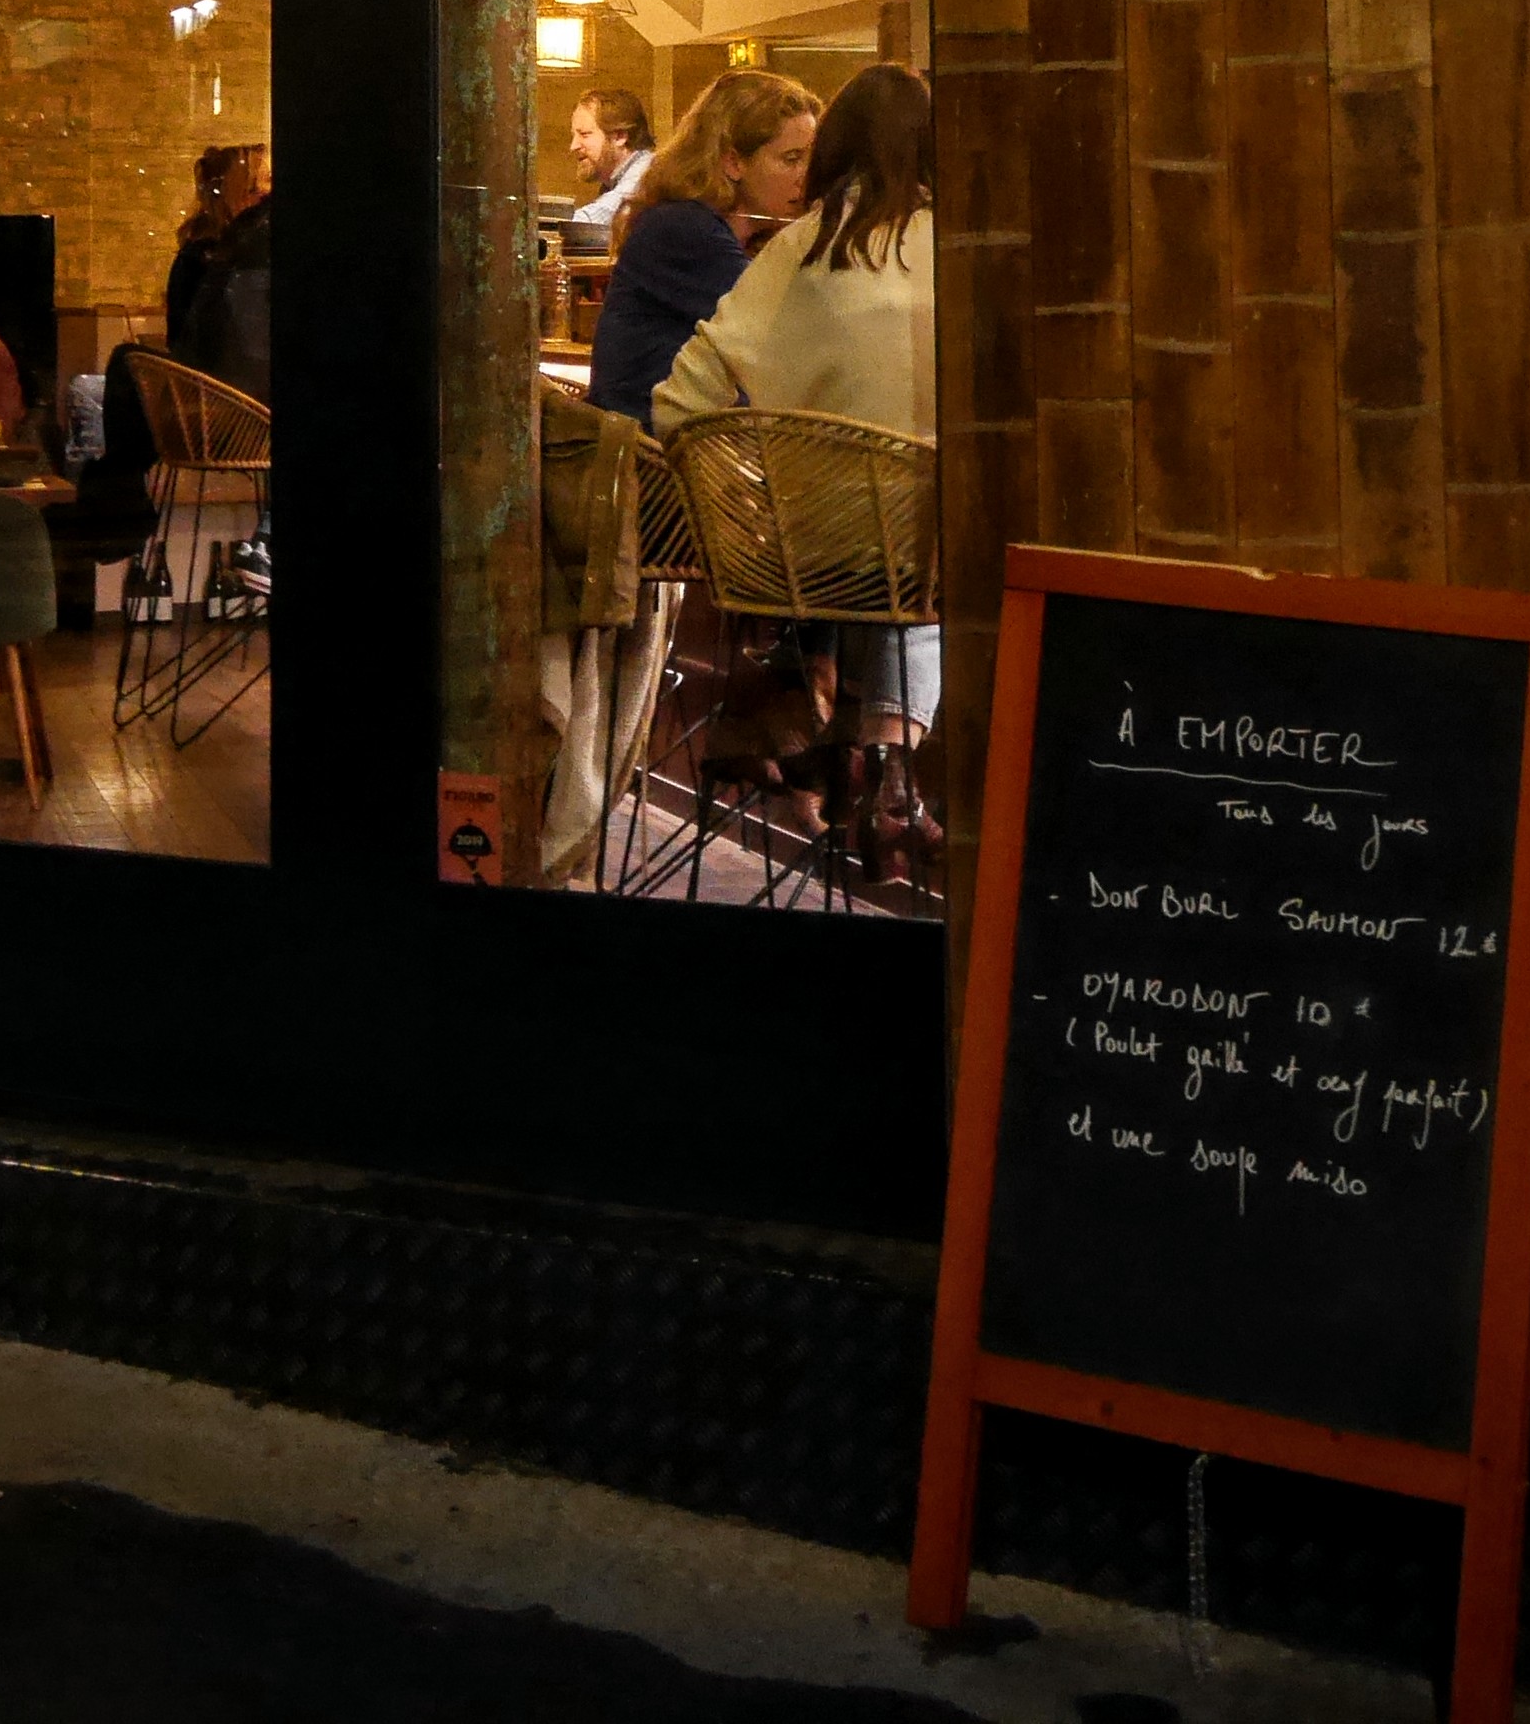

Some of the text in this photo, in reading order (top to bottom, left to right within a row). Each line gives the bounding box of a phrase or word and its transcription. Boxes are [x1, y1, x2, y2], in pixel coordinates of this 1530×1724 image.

[1179, 716, 1396, 765] EMPORTER
[1217, 801, 1273, 825] Tous
[1303, 804, 1336, 830] les
[1279, 898, 1424, 941] SAUMON
[1272, 1056, 1300, 1087] et
[1068, 1106, 1366, 1215] et une soupe miso
